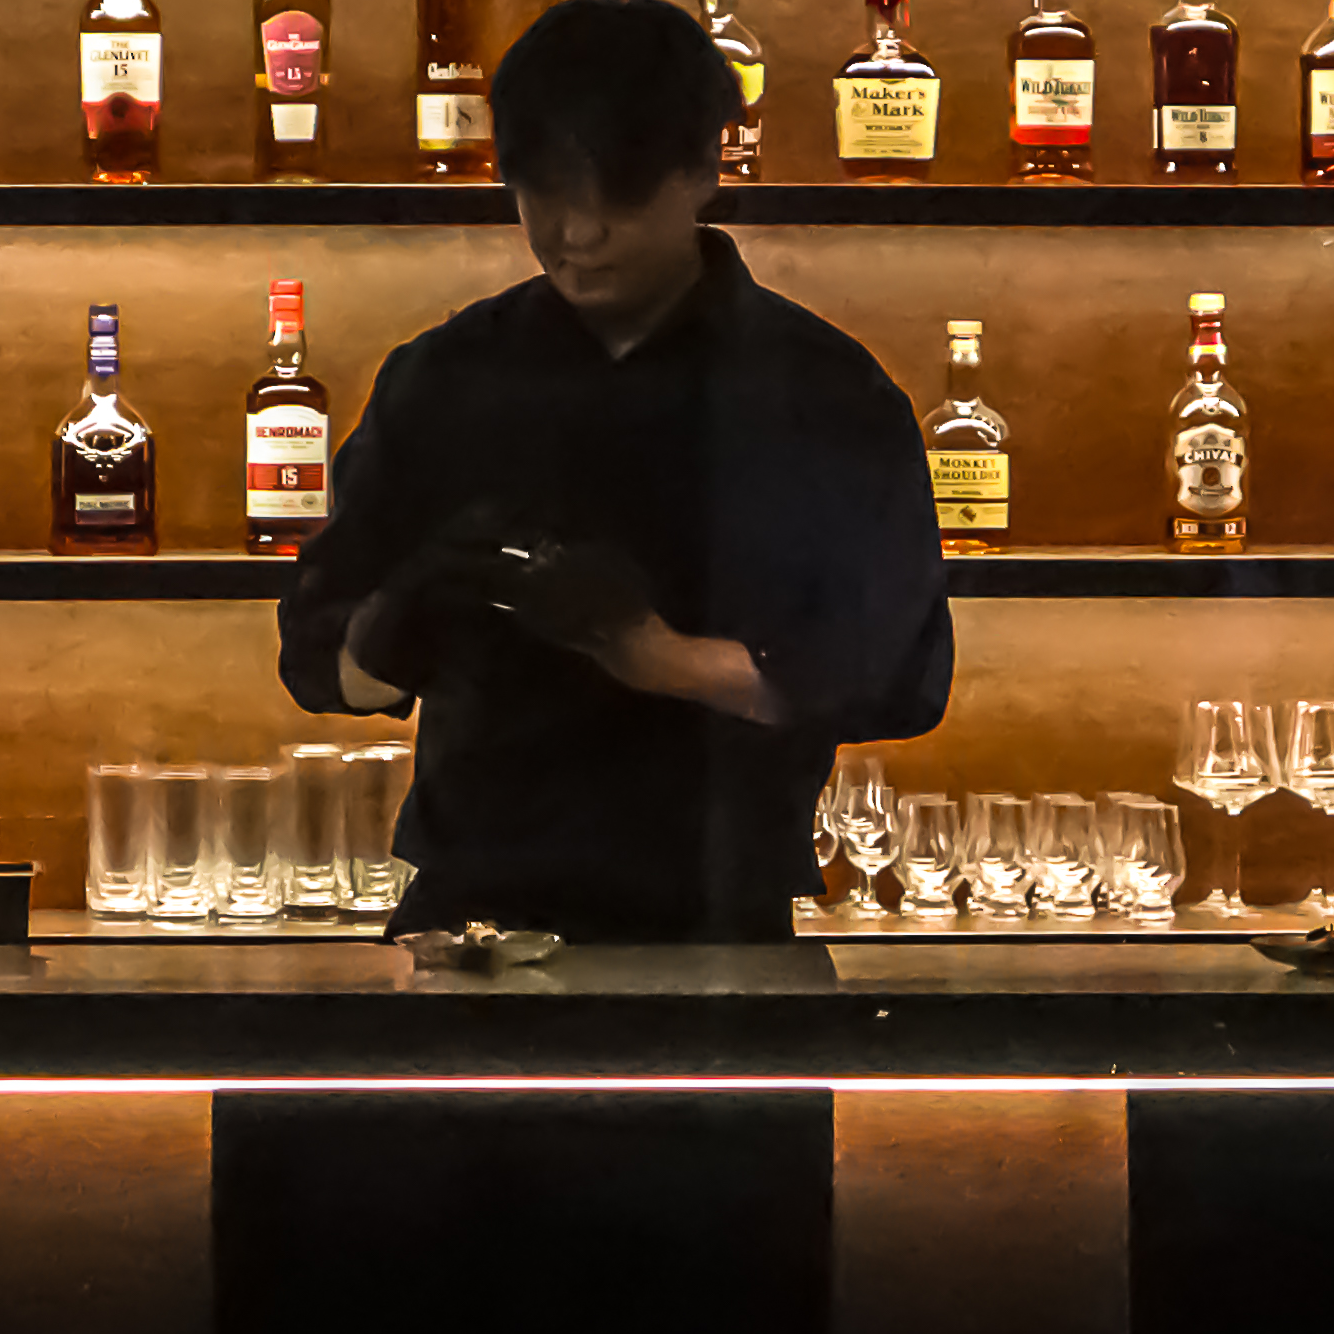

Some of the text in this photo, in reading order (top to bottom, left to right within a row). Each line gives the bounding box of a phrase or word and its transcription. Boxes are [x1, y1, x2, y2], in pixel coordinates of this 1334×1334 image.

[113, 63, 128, 77] 15
[287, 67, 301, 80] 15
[851, 85, 926, 101] Maker's
[872, 103, 925, 117] Mark
[1184, 449, 1237, 464] CHIVAS
[280, 466, 298, 486] 15
